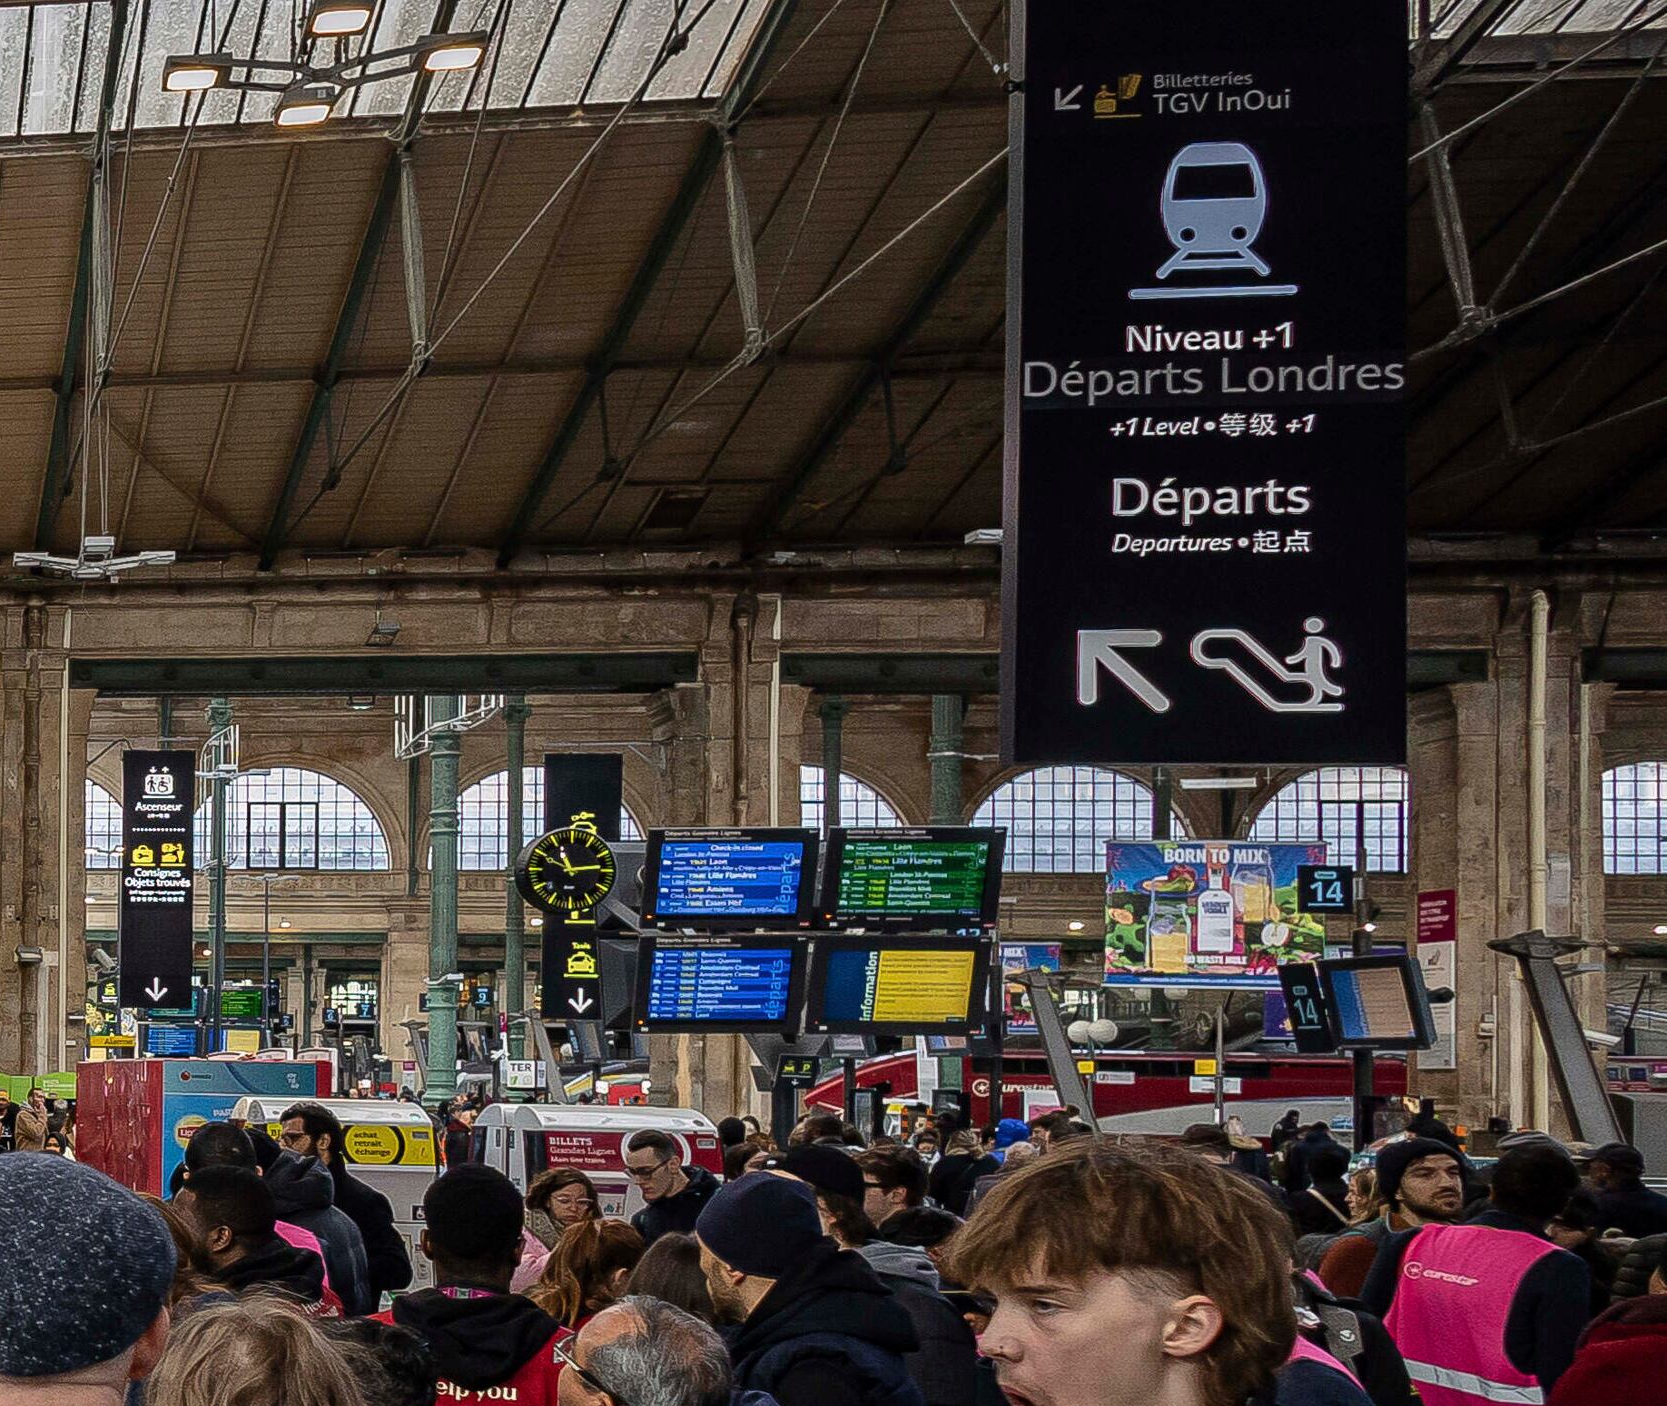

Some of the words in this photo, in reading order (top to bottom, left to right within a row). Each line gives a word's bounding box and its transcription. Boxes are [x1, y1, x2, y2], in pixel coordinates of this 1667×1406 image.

[1153, 71, 1254, 89] Billetteries
[1153, 91, 1209, 115] TGV
[1218, 89, 1291, 113] InOui
[1126, 326, 1244, 352] Niveau
[1252, 322, 1294, 350] +1
[1022, 357, 1204, 405] Départs
[1220, 354, 1406, 394] Londres
[1109, 418, 1137, 437] +1
[1142, 415, 1200, 436] Level
[1219, 412, 1277, 437] 等级
[1285, 414, 1315, 435] +1
[1113, 476, 1312, 526] Départs
[1112, 532, 1233, 557] Departures
[1252, 529, 1312, 555] 起点
[135, 801, 184, 812] Ascenseur
[1164, 849, 1207, 864] BORN
[1210, 848, 1230, 864] TO
[1233, 848, 1264, 864] MIX
[124, 877, 155, 889] Objets
[156, 877, 191, 888] trouvés
[134, 868, 182, 879] Consignes
[1310, 881, 1344, 902] 14
[1294, 998, 1318, 1024] 14
[510, 1062, 532, 1072] TER
[549, 1136, 593, 1146] BILLETS
[436, 1381, 469, 1401] elp
[476, 1385, 518, 1402] you
